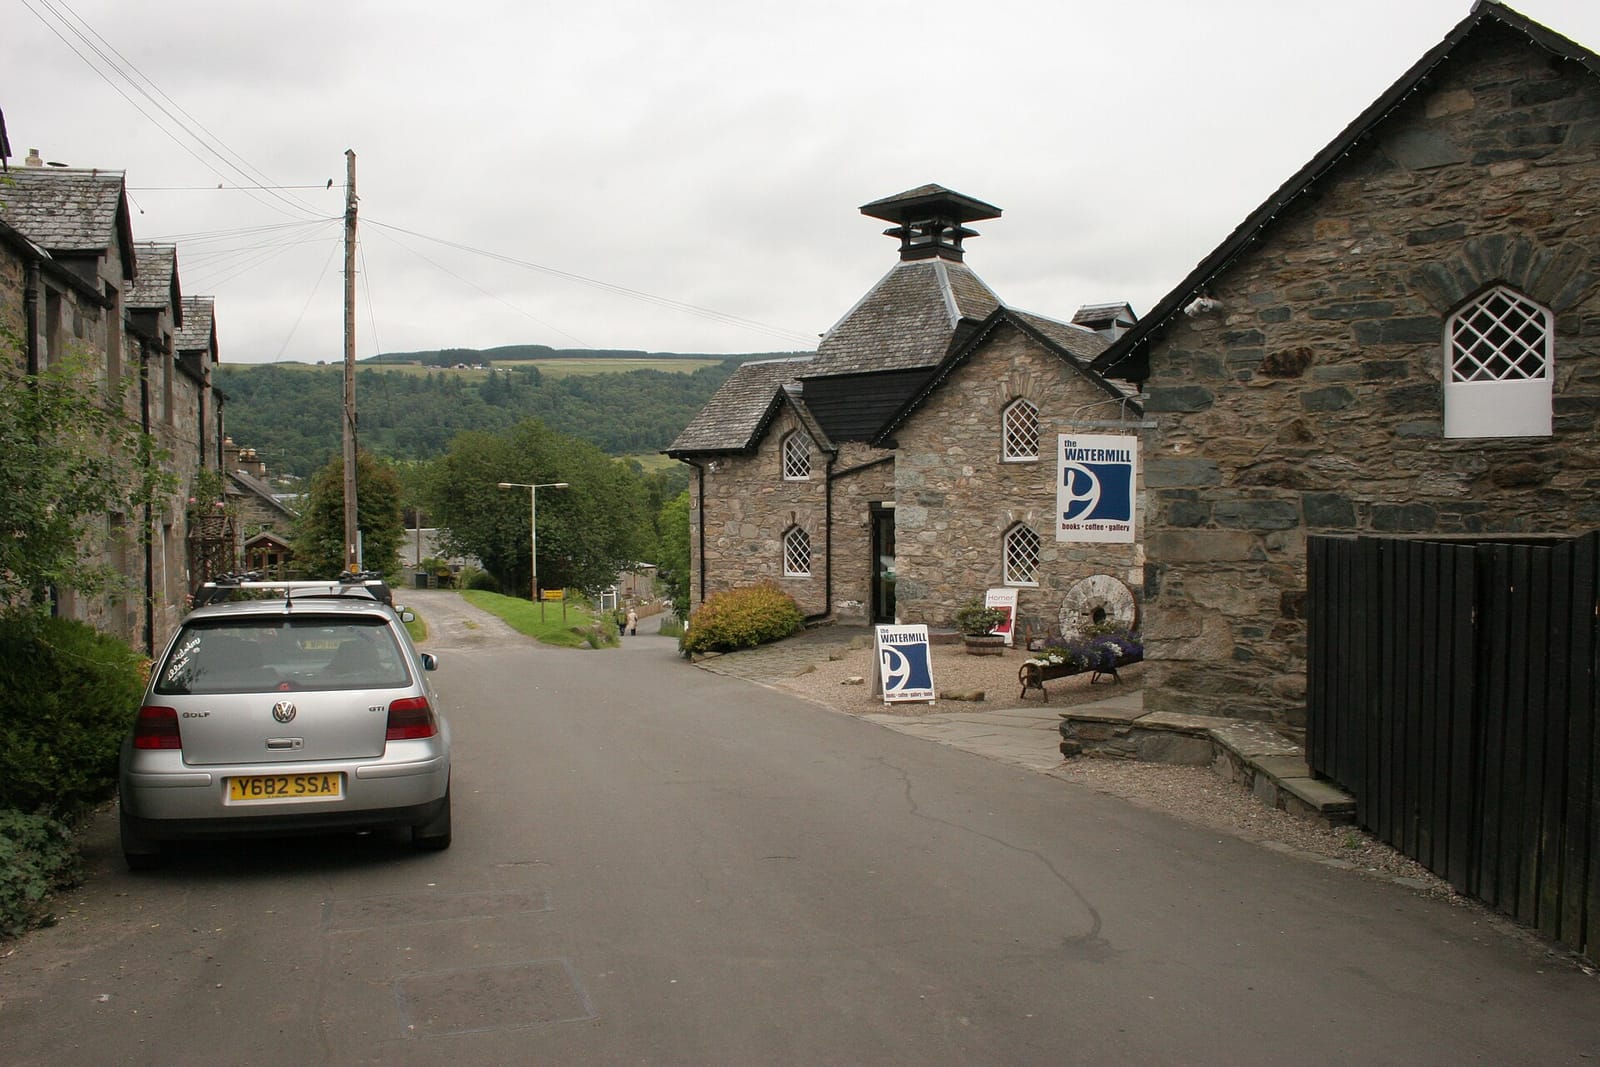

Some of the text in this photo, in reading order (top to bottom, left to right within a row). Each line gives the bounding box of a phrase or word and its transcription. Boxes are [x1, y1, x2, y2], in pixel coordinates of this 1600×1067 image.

[1064, 448, 1131, 462] WATERMILL
[880, 632, 927, 643] WATERMILL
[182, 711, 210, 719] GOLF
[238, 776, 331, 796] Y682 SSA
